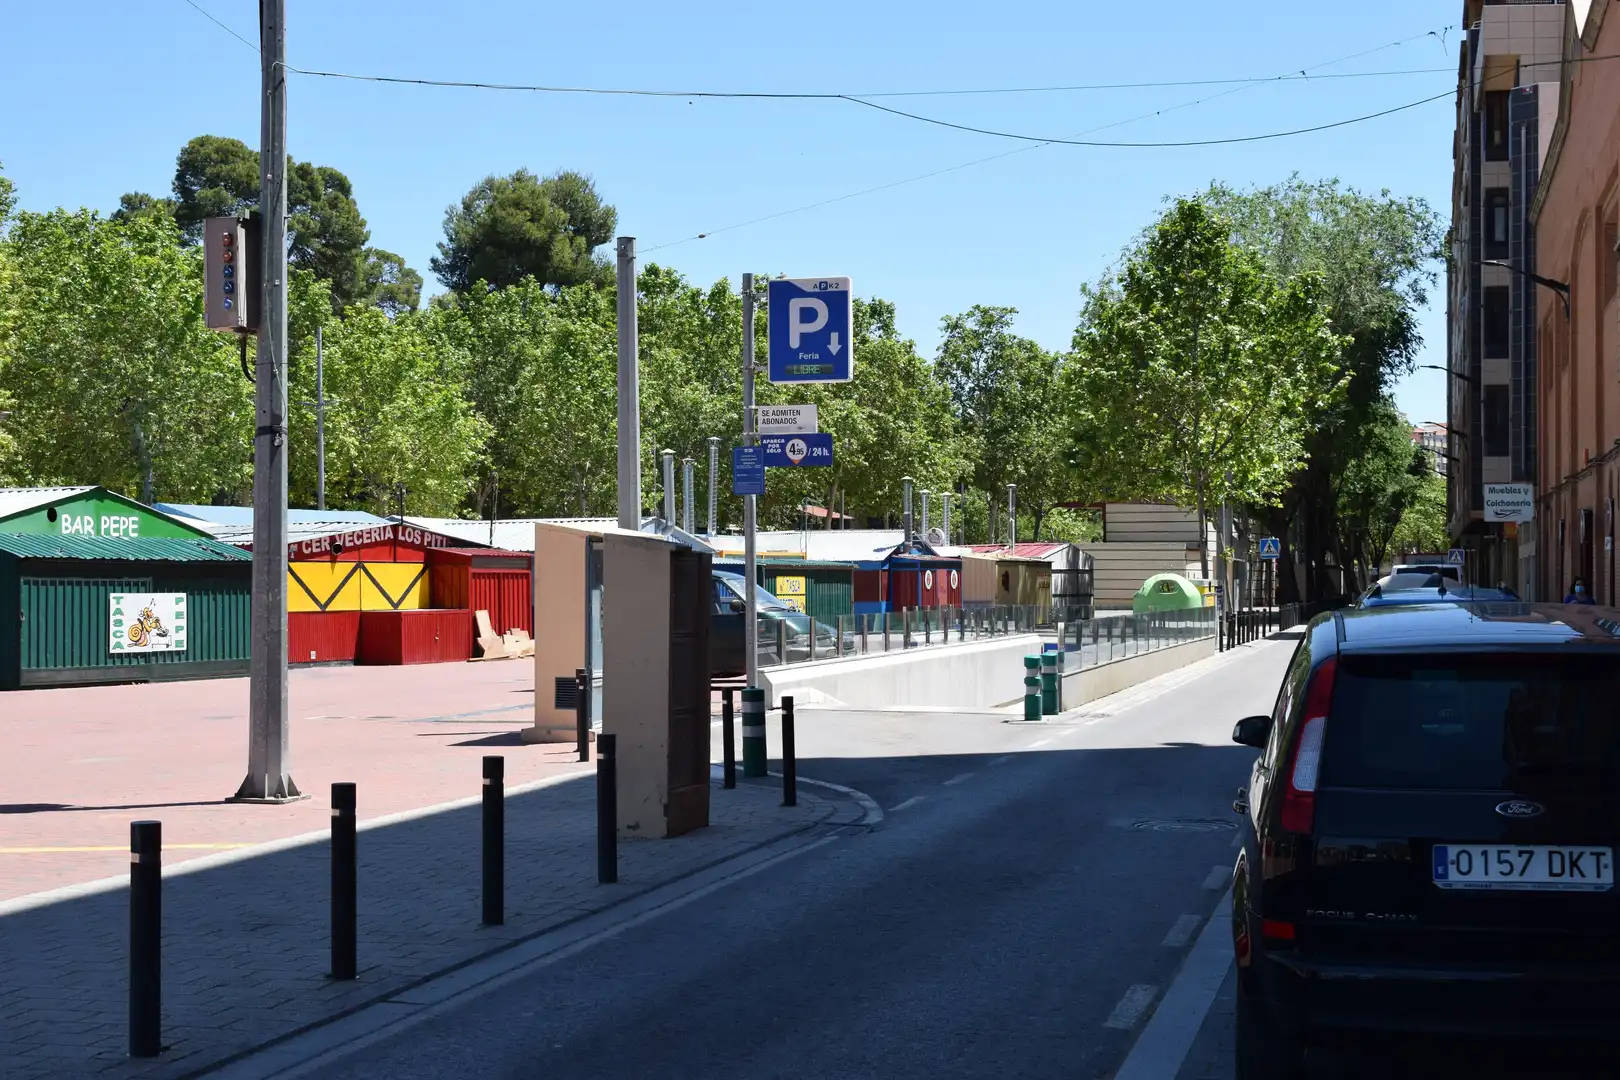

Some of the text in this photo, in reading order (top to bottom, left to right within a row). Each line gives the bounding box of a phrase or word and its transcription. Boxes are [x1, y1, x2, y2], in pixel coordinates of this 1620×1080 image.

[789, 297, 829, 349] P
[798, 352, 820, 360] Feria
[794, 364, 821, 375] LIBRE
[761, 417, 798, 425] ABONADOS
[813, 447, 822, 456] 24
[1523, 488, 1529, 496] y
[61, 514, 139, 537] BAR PEPE
[398, 526, 422, 545] LOS
[112, 596, 184, 650] TASCA PEPE
[1508, 803, 1533, 814] Ford
[1455, 849, 1606, 879] 0157 DKT
[1307, 909, 1355, 919] FOCUS
